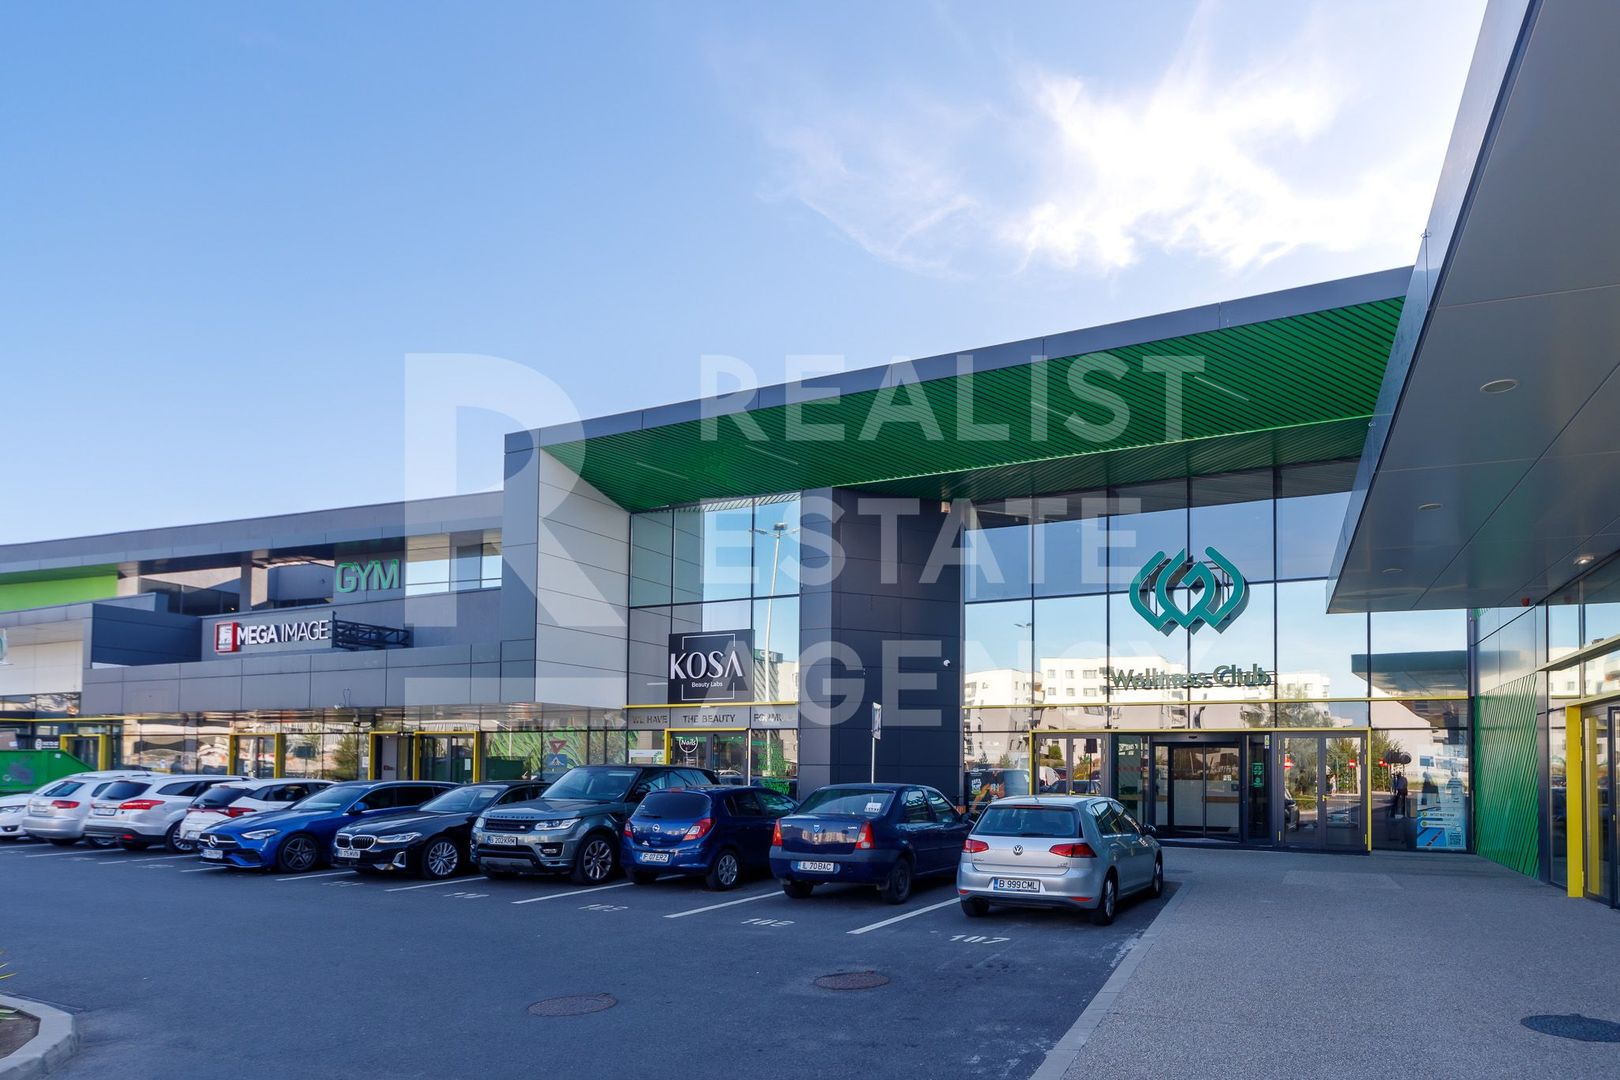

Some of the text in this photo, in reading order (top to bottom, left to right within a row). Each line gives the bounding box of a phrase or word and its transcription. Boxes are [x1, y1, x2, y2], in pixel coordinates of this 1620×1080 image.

[335, 558, 401, 593] GYM
[236, 619, 329, 646] MEGA IMAGE
[670, 650, 743, 680] KOSA
[1110, 663, 1268, 691] Wellness Club
[646, 715, 668, 724] HAVE
[682, 714, 698, 723] THE
[702, 713, 736, 723] BEAUTY
[999, 879, 1005, 888] B
